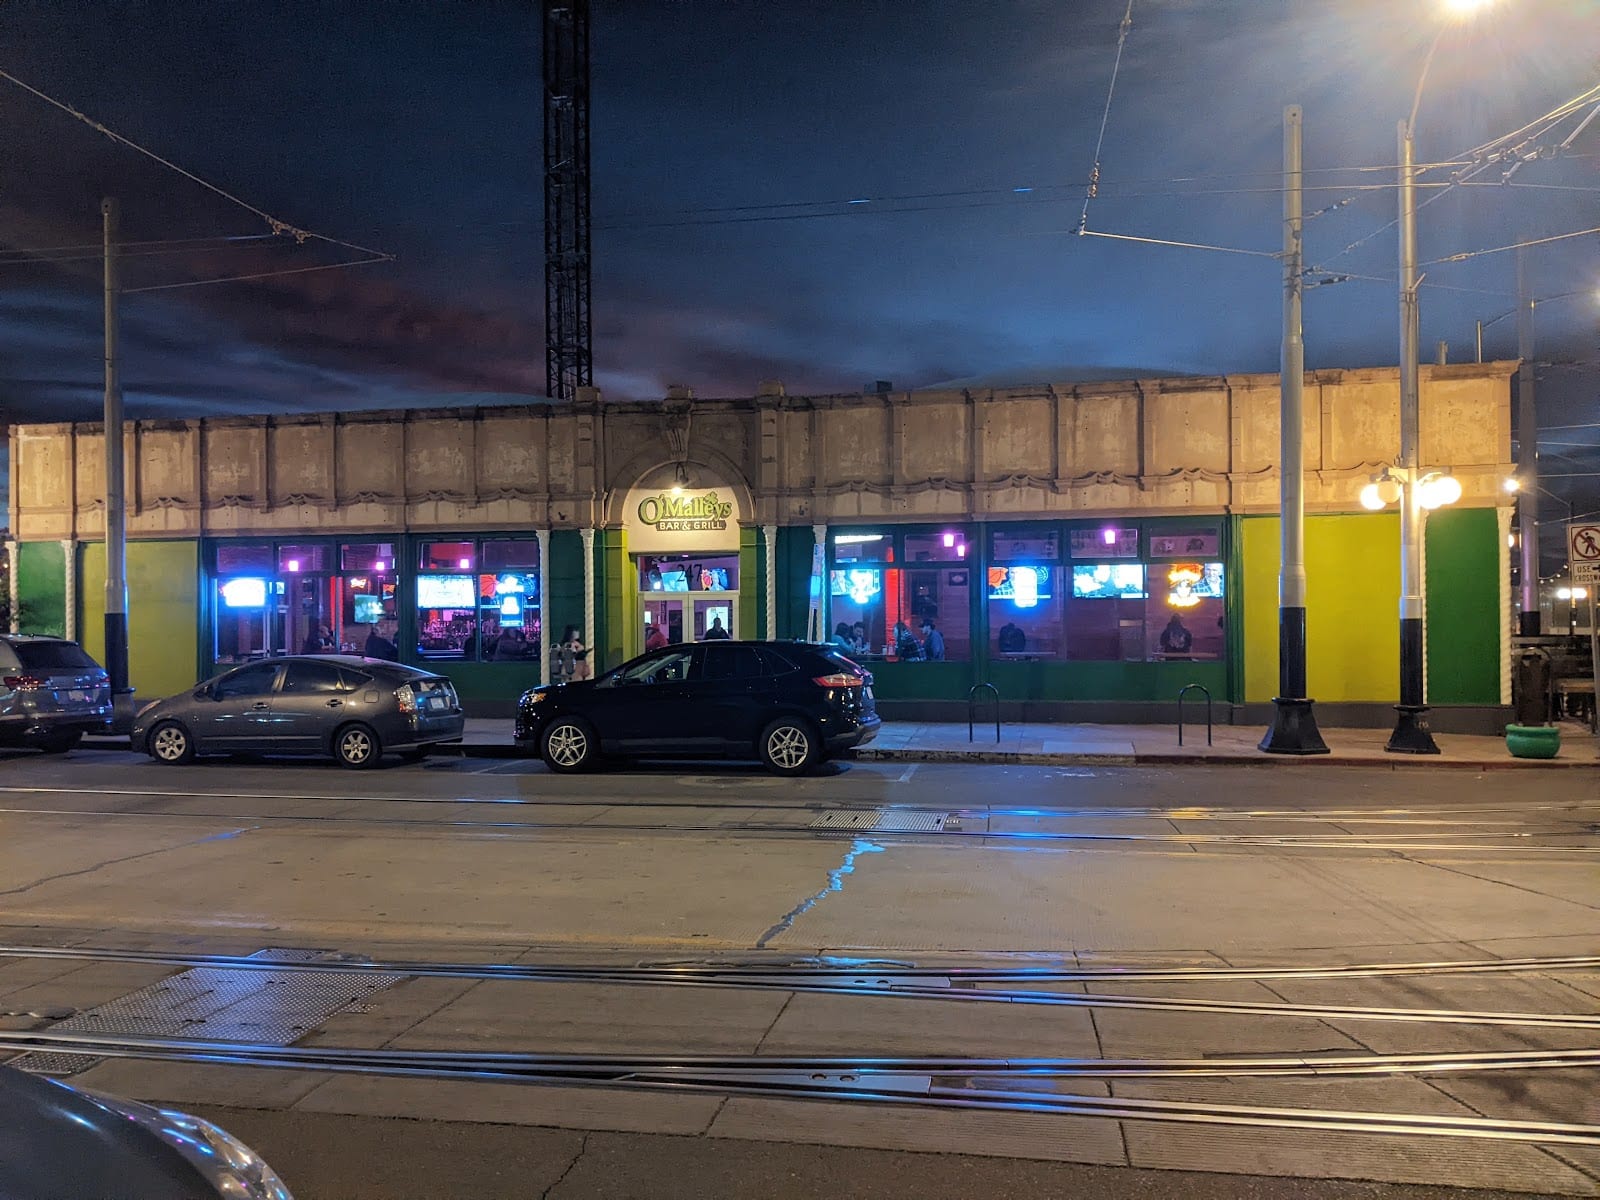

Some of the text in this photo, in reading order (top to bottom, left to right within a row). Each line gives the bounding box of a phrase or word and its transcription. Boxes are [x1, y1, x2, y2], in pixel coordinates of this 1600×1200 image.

[659, 521, 723, 531] BAR & GRILL
[676, 563, 703, 582] 247
[1576, 565, 1592, 574] USE
